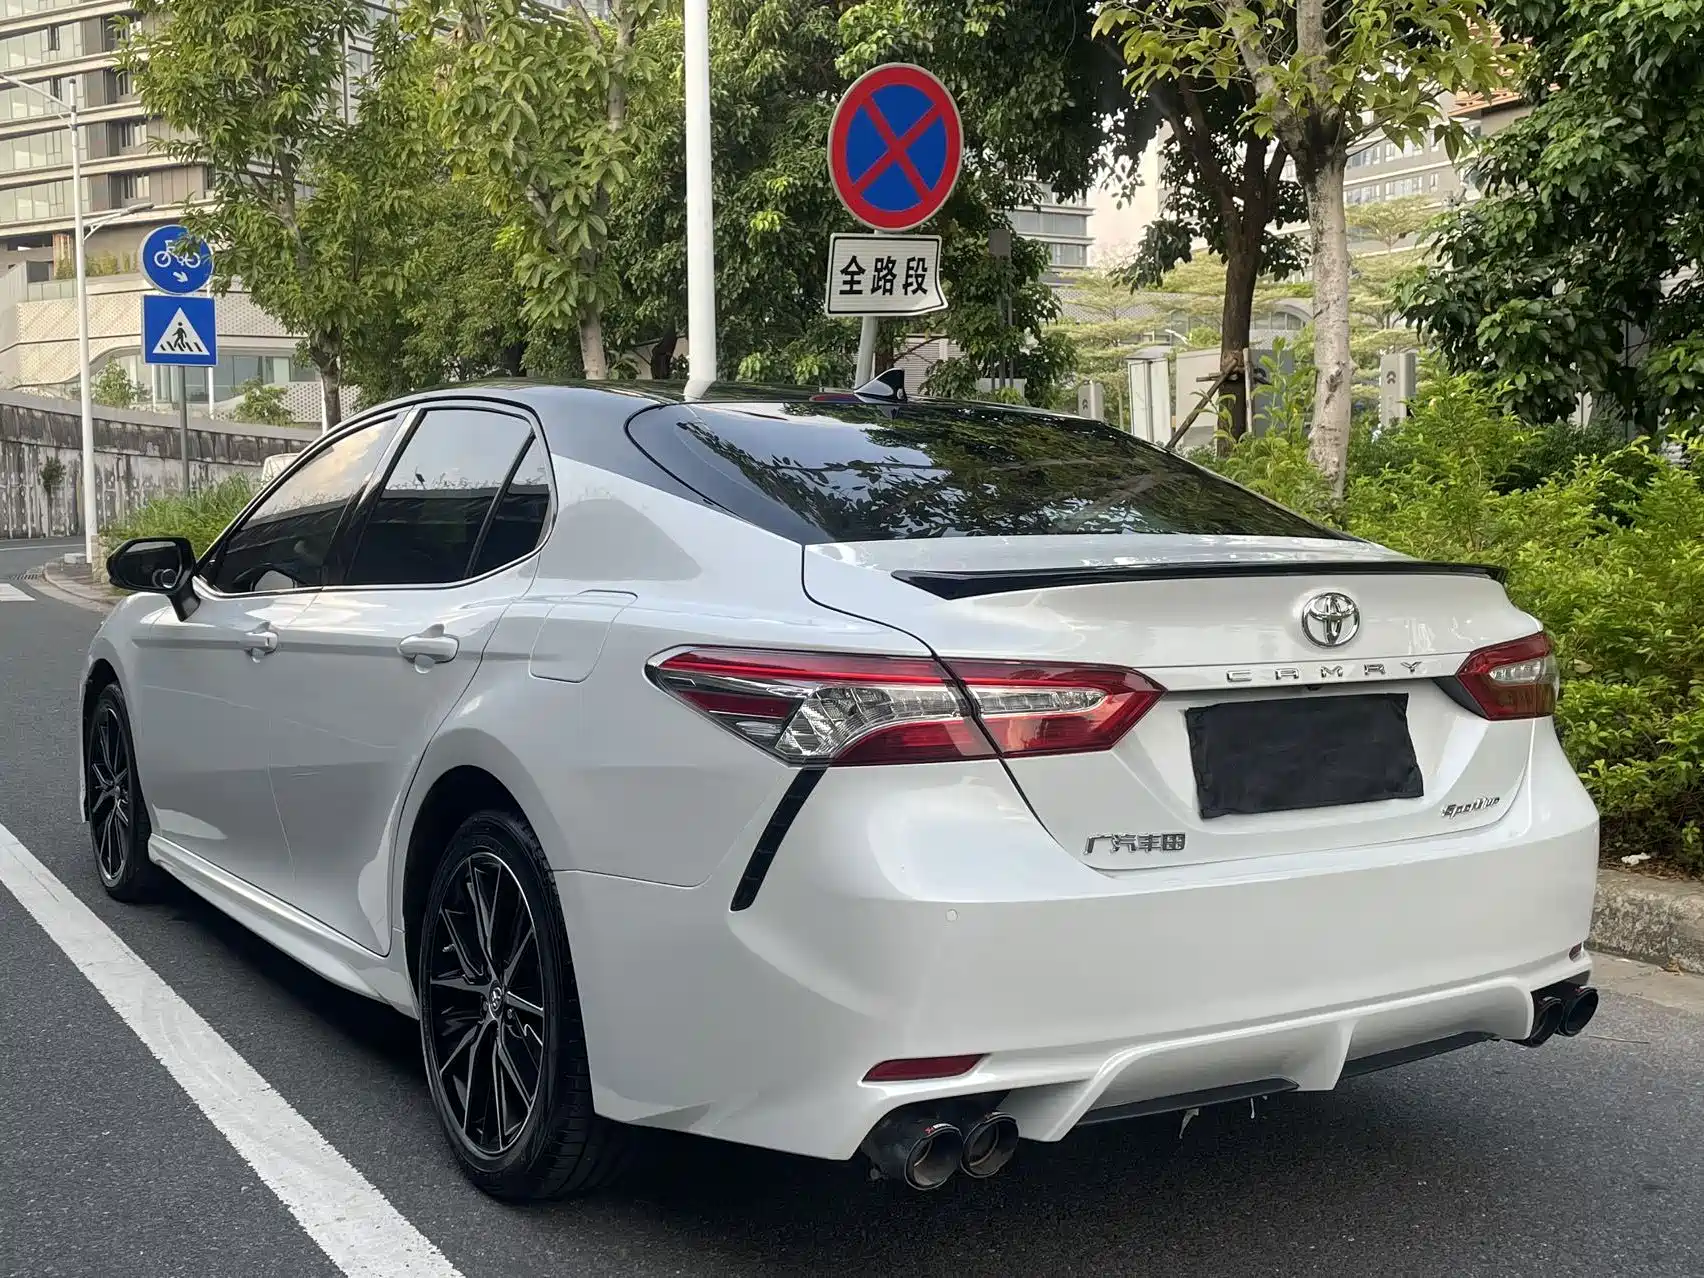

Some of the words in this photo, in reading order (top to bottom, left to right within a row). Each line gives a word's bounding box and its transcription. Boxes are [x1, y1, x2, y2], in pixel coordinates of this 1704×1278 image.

[839, 255, 928, 296] 全路段
[1226, 661, 1422, 682] CAMRY
[1084, 833, 1186, 855] 广汽丰田
